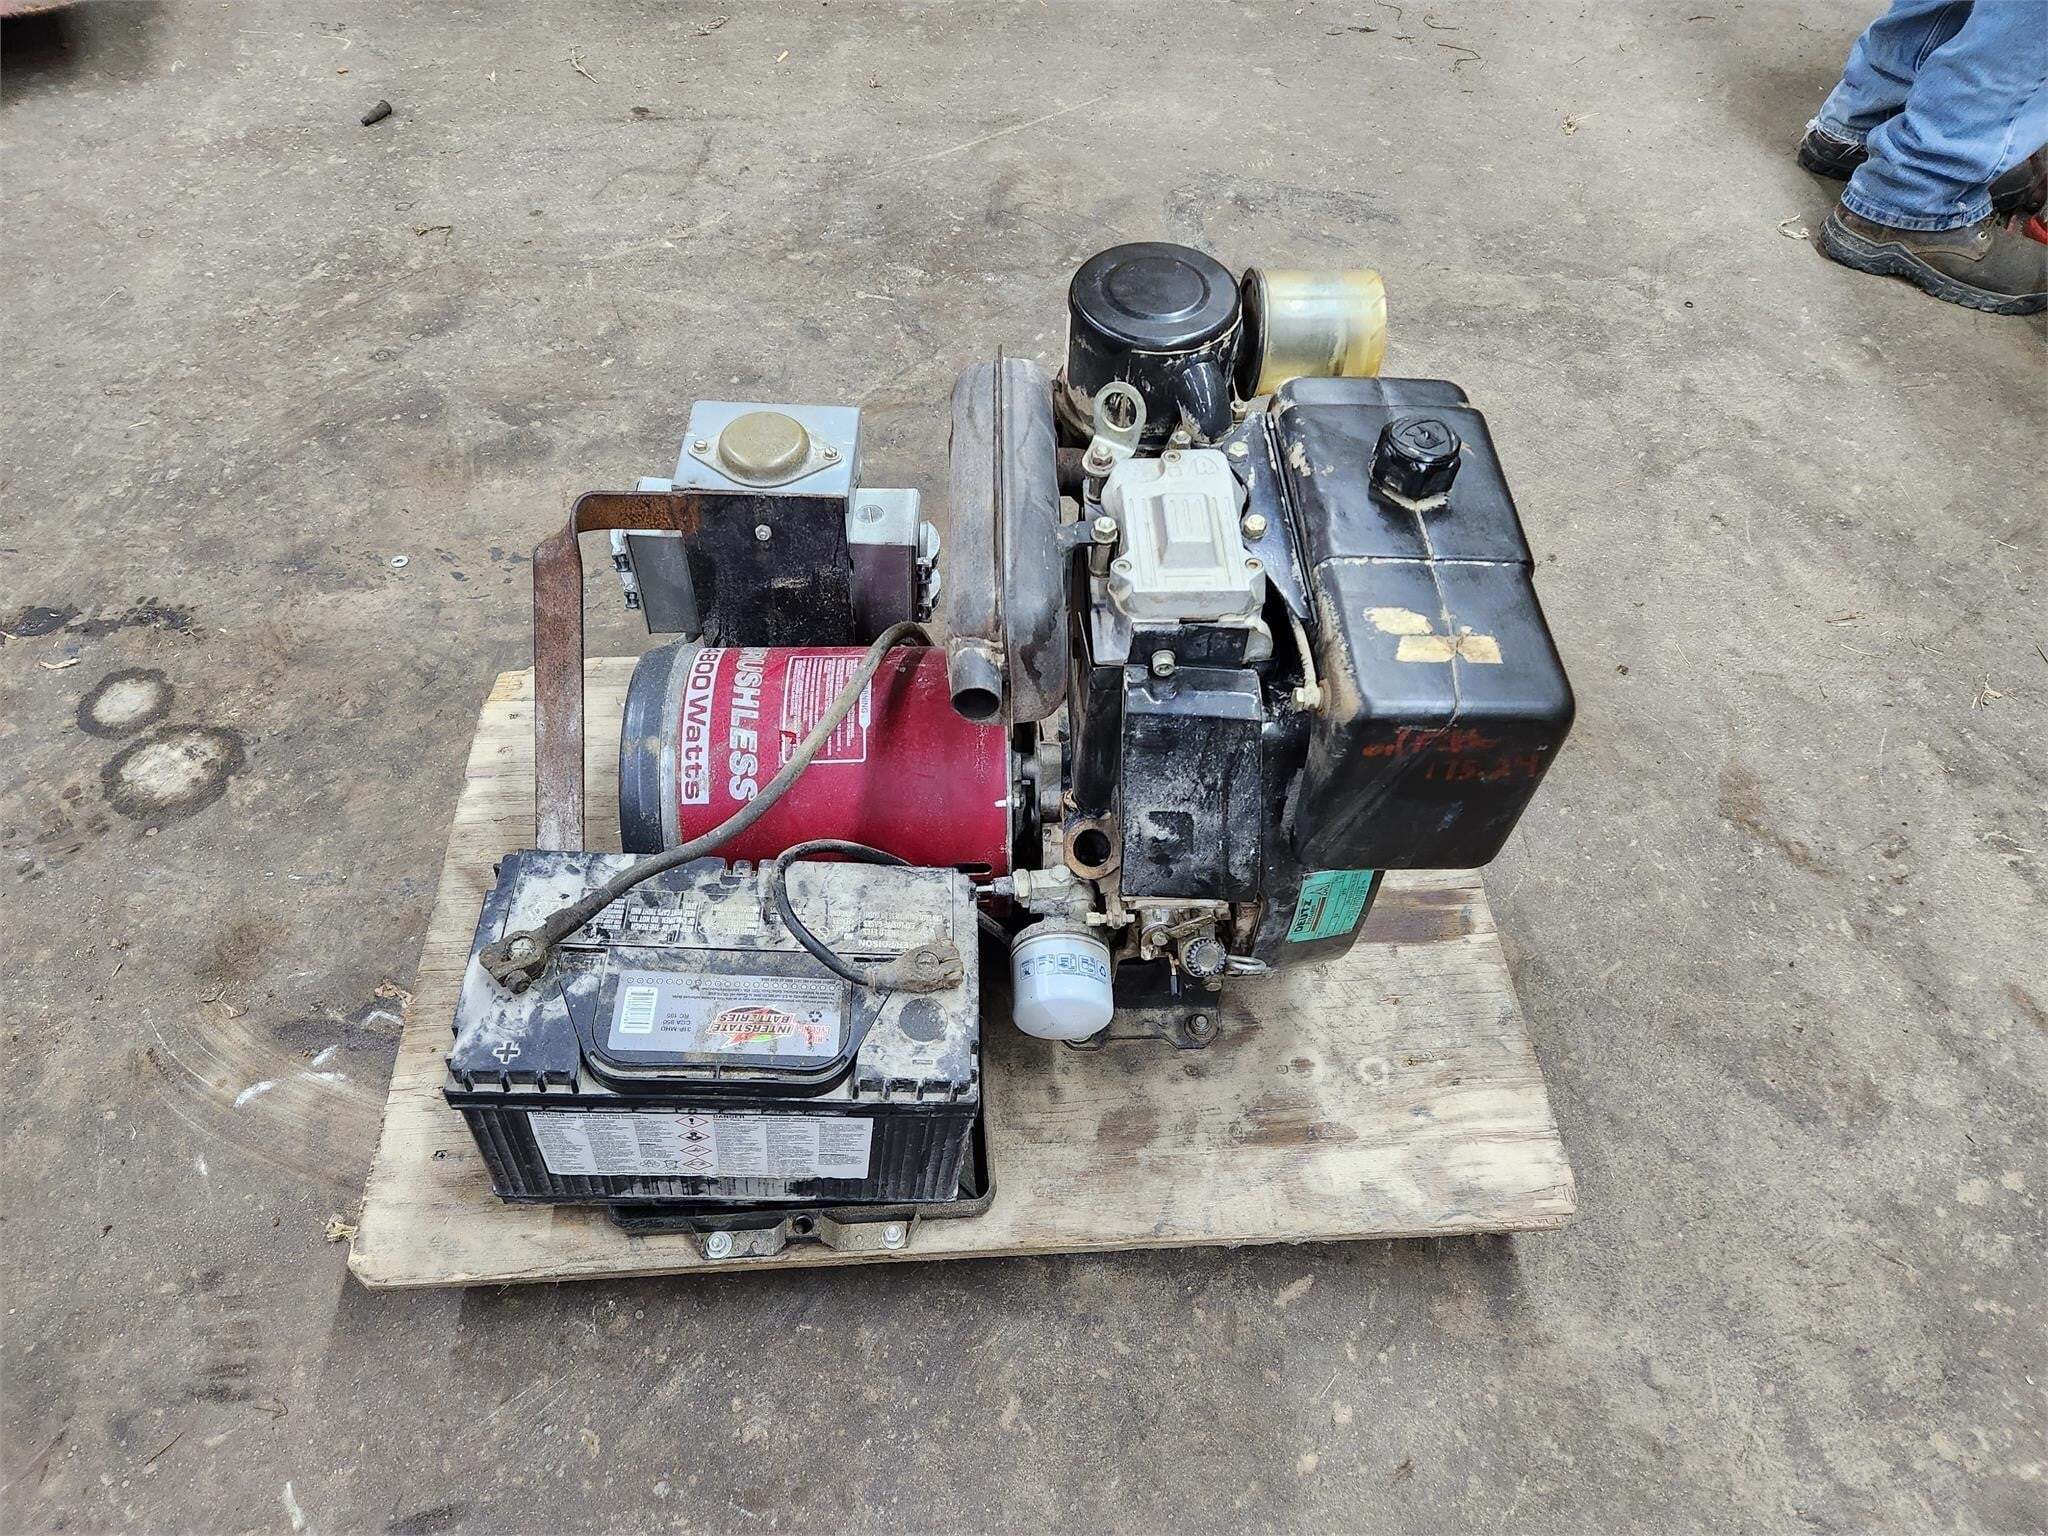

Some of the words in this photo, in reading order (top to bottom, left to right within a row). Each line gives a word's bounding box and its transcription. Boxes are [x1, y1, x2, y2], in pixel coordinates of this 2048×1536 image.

[684, 694, 709, 800] Watts
[638, 915, 650, 923] NOT
[1293, 899, 1313, 933] DEUTZ
[630, 923, 648, 931] REACH
[719, 1014, 790, 1024] BATTERIES
[713, 1023, 792, 1034] INTERSTATE
